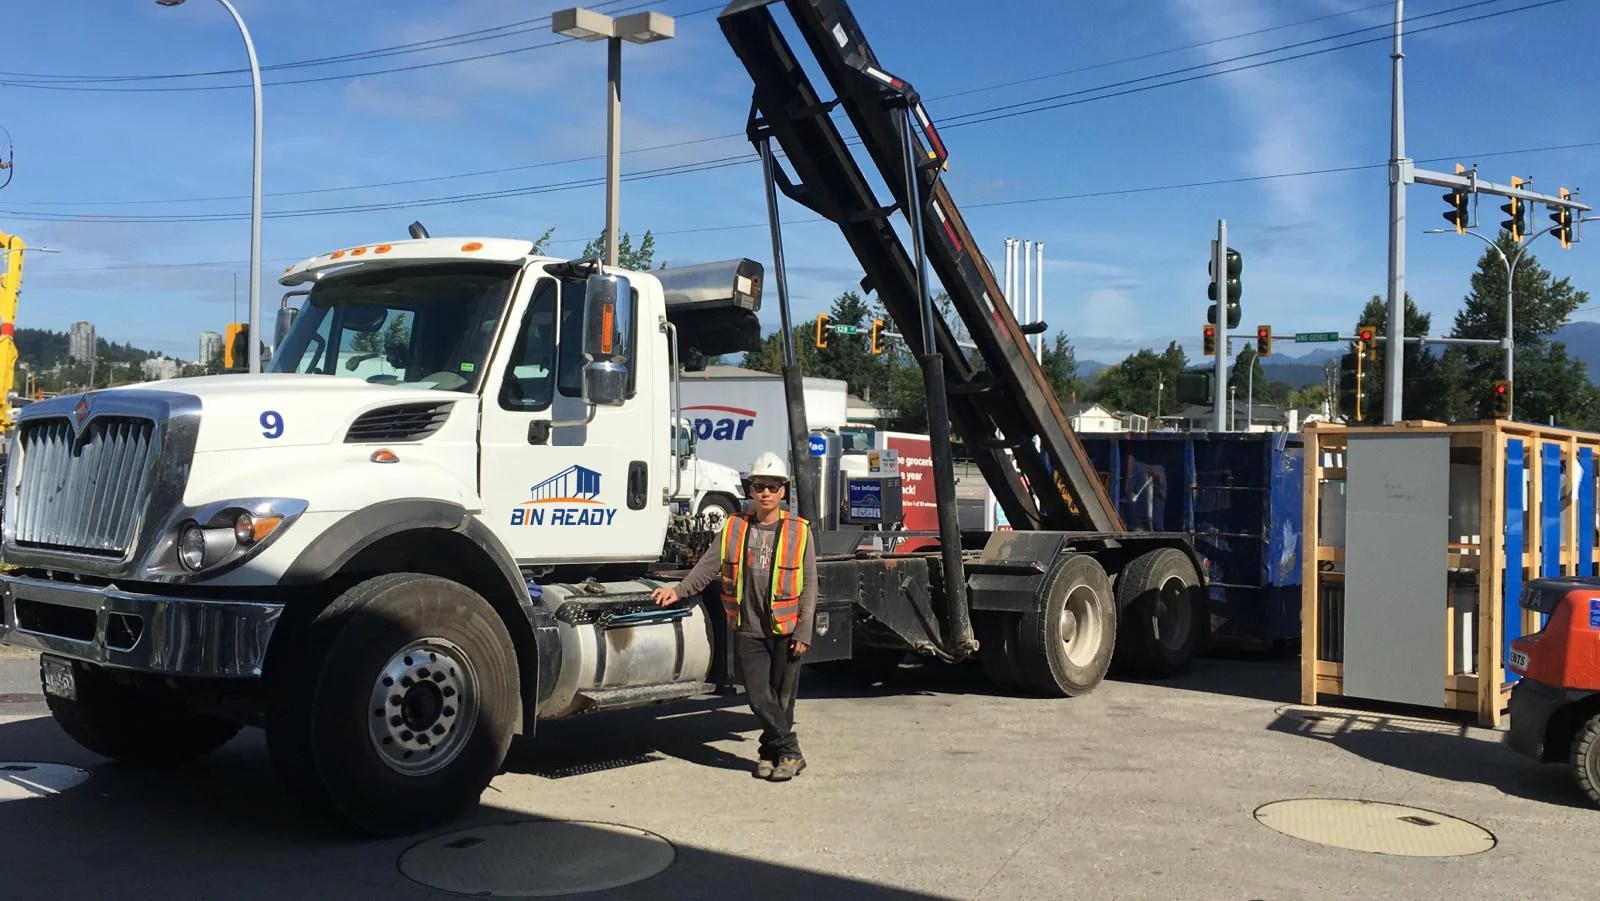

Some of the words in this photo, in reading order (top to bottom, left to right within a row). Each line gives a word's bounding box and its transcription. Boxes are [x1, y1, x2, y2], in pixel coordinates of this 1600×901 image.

[1309, 333, 1329, 341] GEORGE
[259, 410, 285, 439] 9
[694, 417, 754, 441] par
[905, 456, 933, 468] groceri
[906, 472, 923, 482] year
[510, 508, 545, 526] BIN
[551, 508, 618, 526] READY
